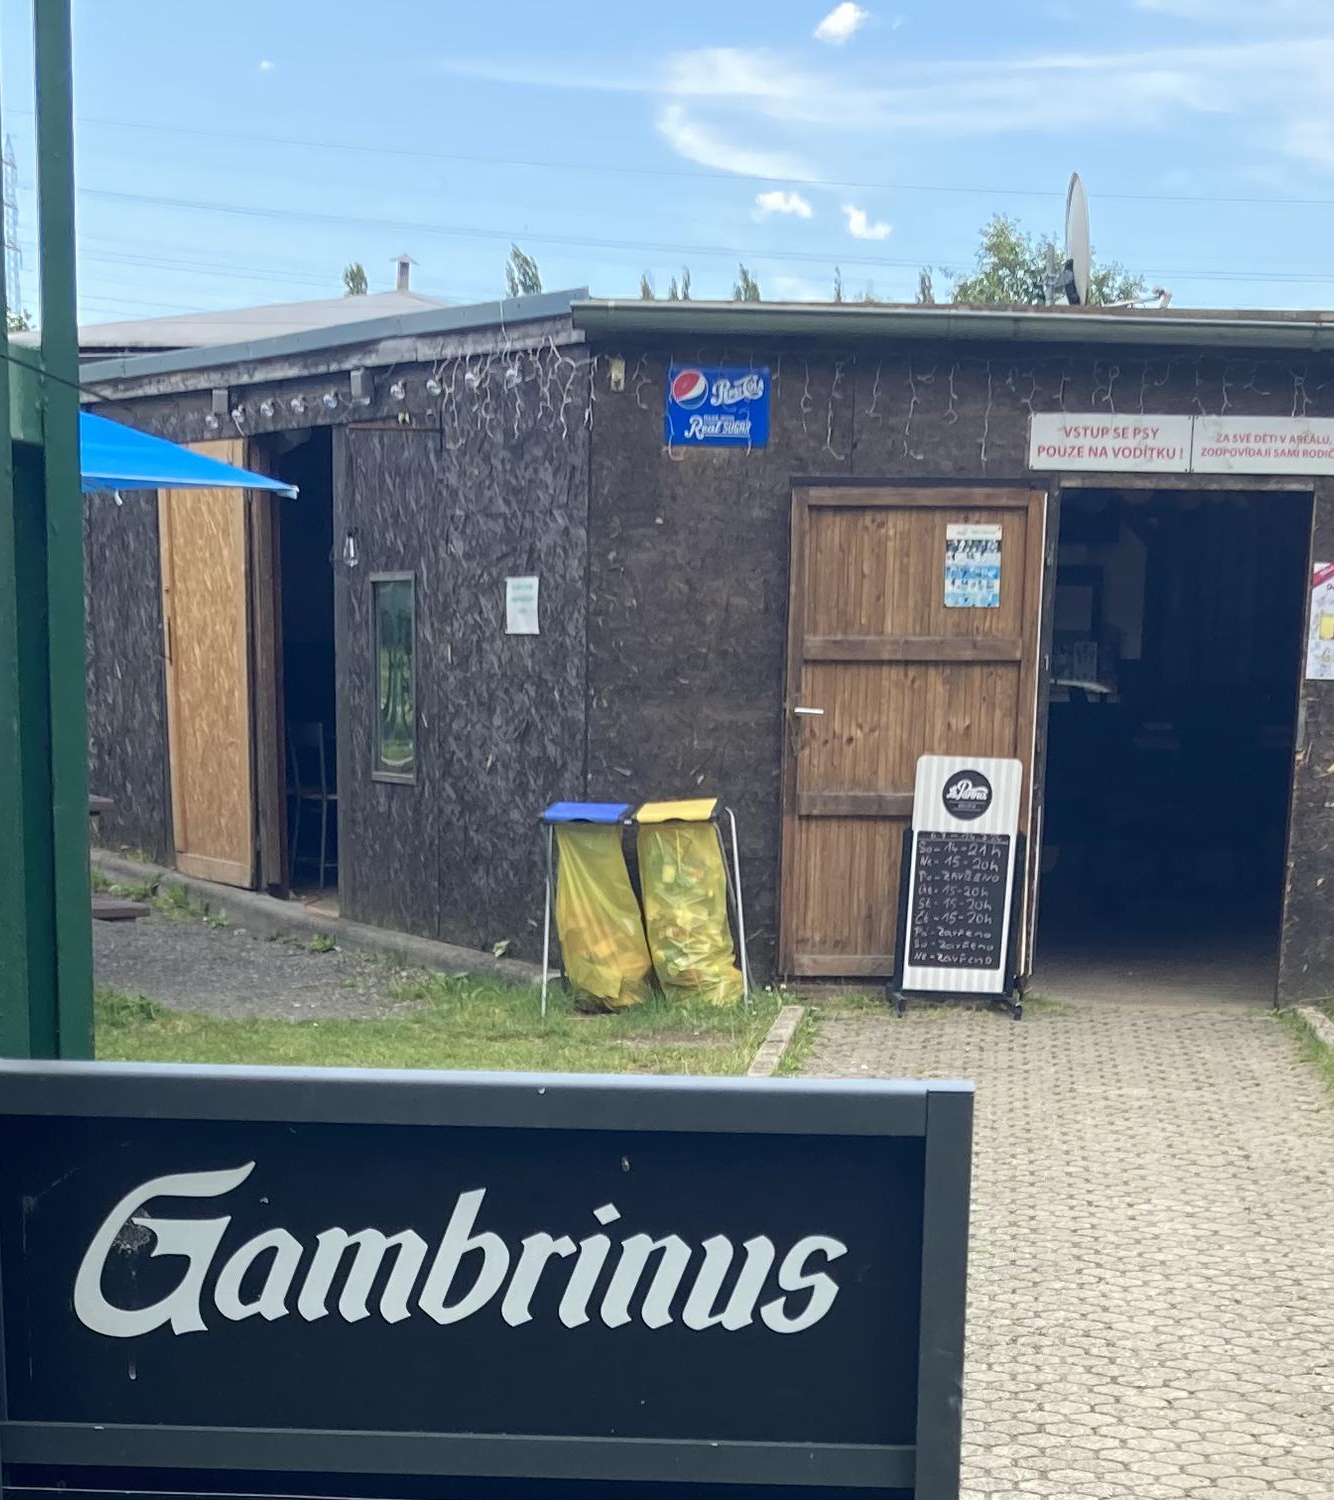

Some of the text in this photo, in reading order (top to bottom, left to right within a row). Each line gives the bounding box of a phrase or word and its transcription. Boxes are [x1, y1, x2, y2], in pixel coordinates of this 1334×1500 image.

[684, 415, 752, 440] Real SUGAR
[1063, 426, 1160, 440] VSTUP SE PSY
[1216, 432, 1230, 444] ZA
[1232, 431, 1252, 444] SVÉ
[1254, 431, 1278, 444] DĚTI
[1280, 433, 1288, 444] V
[1037, 446, 1085, 459] POUZE
[1088, 446, 1108, 459] NA
[1110, 444, 1175, 460] VODÍTKU
[1273, 447, 1300, 460] SAMI
[73, 1160, 848, 1338] Gambrinus
